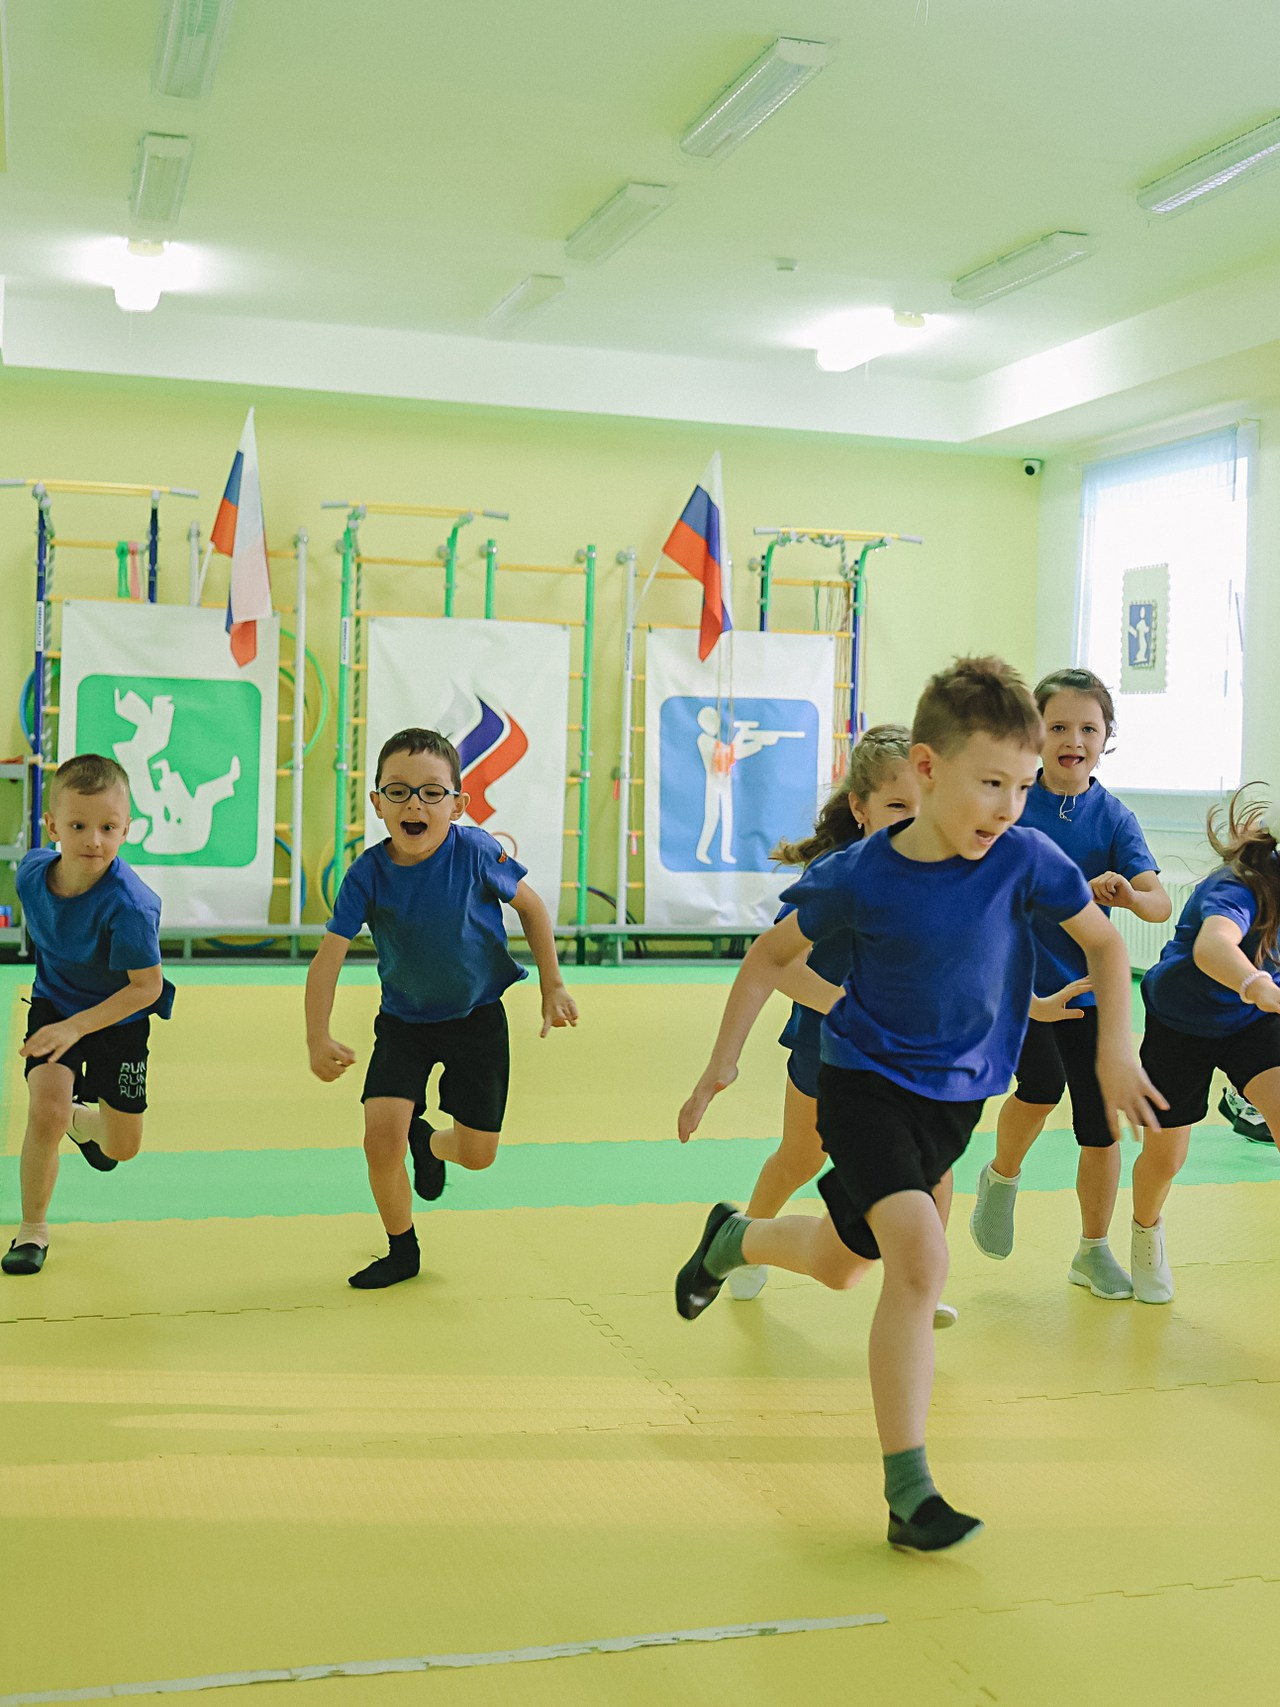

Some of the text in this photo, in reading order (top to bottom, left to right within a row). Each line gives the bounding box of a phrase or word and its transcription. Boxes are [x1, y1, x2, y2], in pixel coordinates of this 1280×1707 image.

[120, 1061, 146, 1074] RUN
[118, 1073, 145, 1086] RUN
[119, 1085, 145, 1099] RUN
